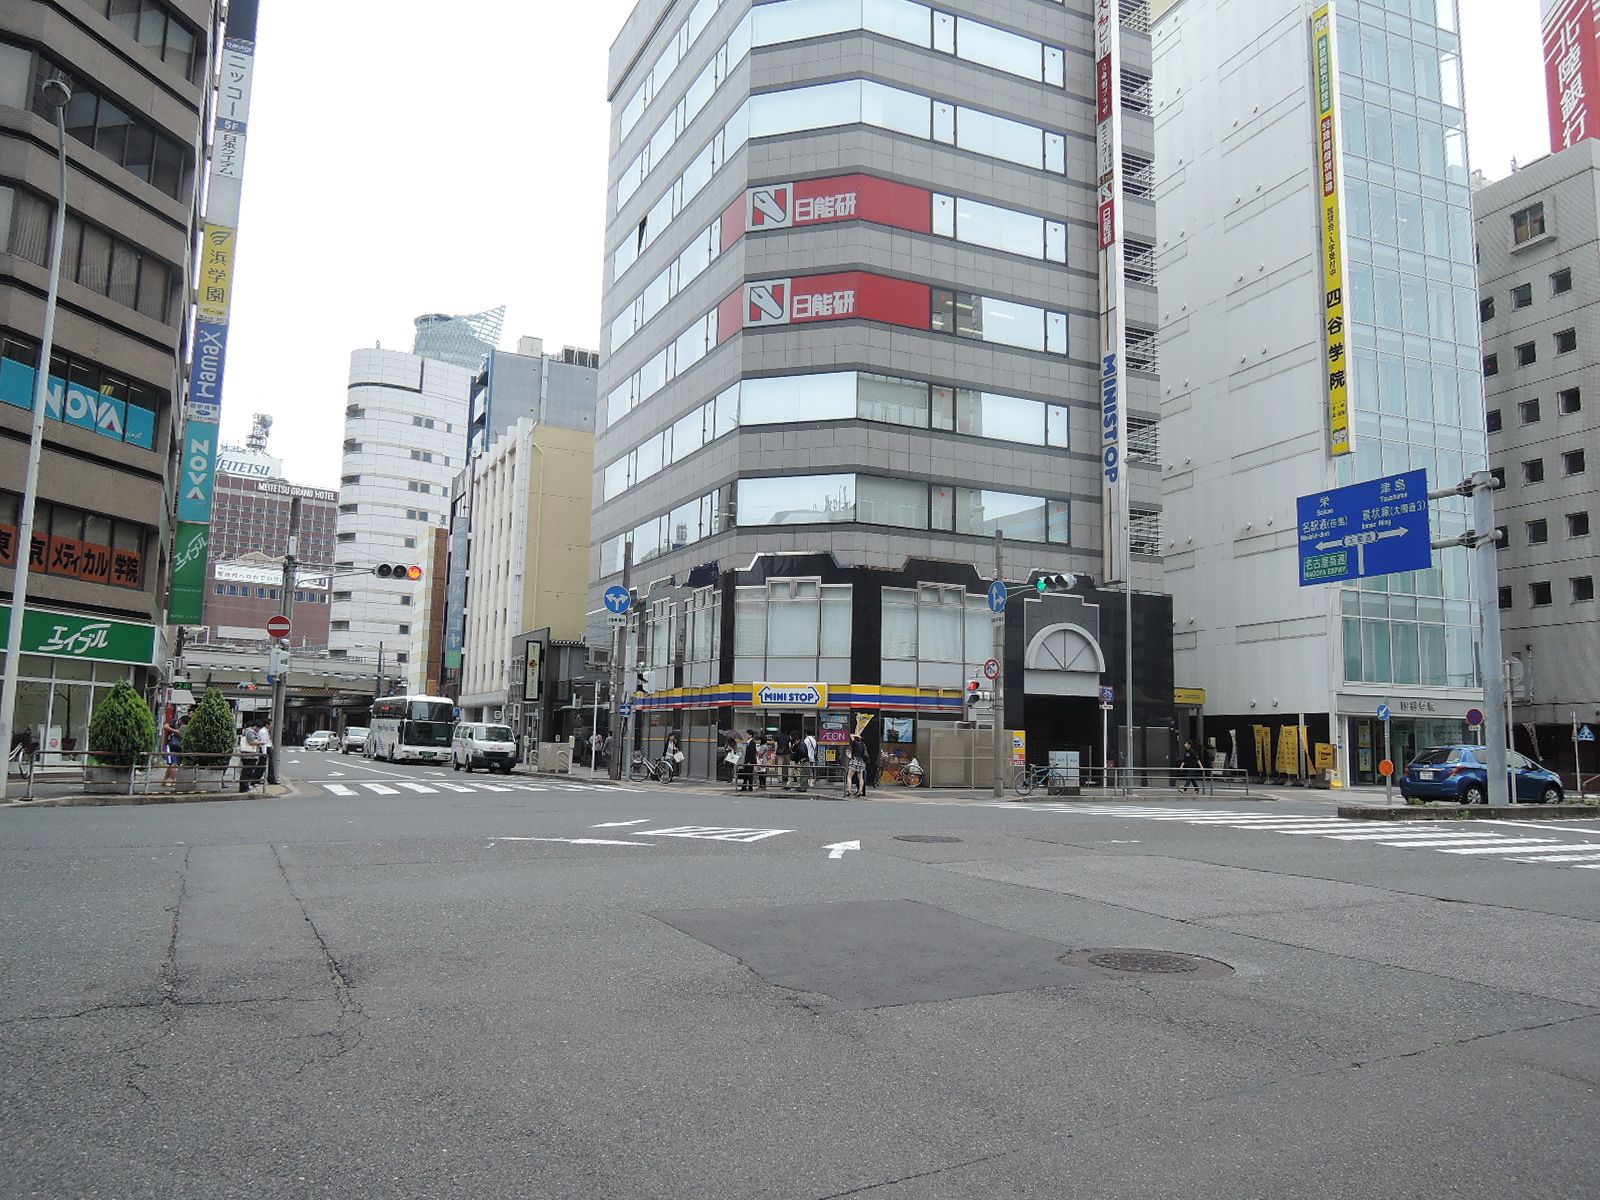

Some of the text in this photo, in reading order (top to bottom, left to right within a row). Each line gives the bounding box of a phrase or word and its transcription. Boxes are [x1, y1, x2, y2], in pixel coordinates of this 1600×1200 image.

[227, 55, 246, 117] ニッコー
[1555, 20, 1585, 147] 北陸銀行
[224, 120, 239, 130] 5F
[795, 192, 856, 222] 日能研
[1103, 207, 1111, 245] 日能研
[207, 250, 227, 303] 浜学園
[793, 290, 855, 319] 日能研
[1327, 288, 1345, 391] 四谷学院
[45, 384, 124, 435] NOVA
[186, 438, 210, 499] NOVA
[258, 482, 335, 500] MEITETSU GRAND HOTEL
[1319, 496, 1330, 507] 栄
[1380, 479, 1406, 494] 津島
[174, 532, 208, 572] エイブル
[1305, 569, 1326, 578] NAGOYA
[38, 623, 112, 654] エイブル
[764, 692, 815, 702] MINI STOP
